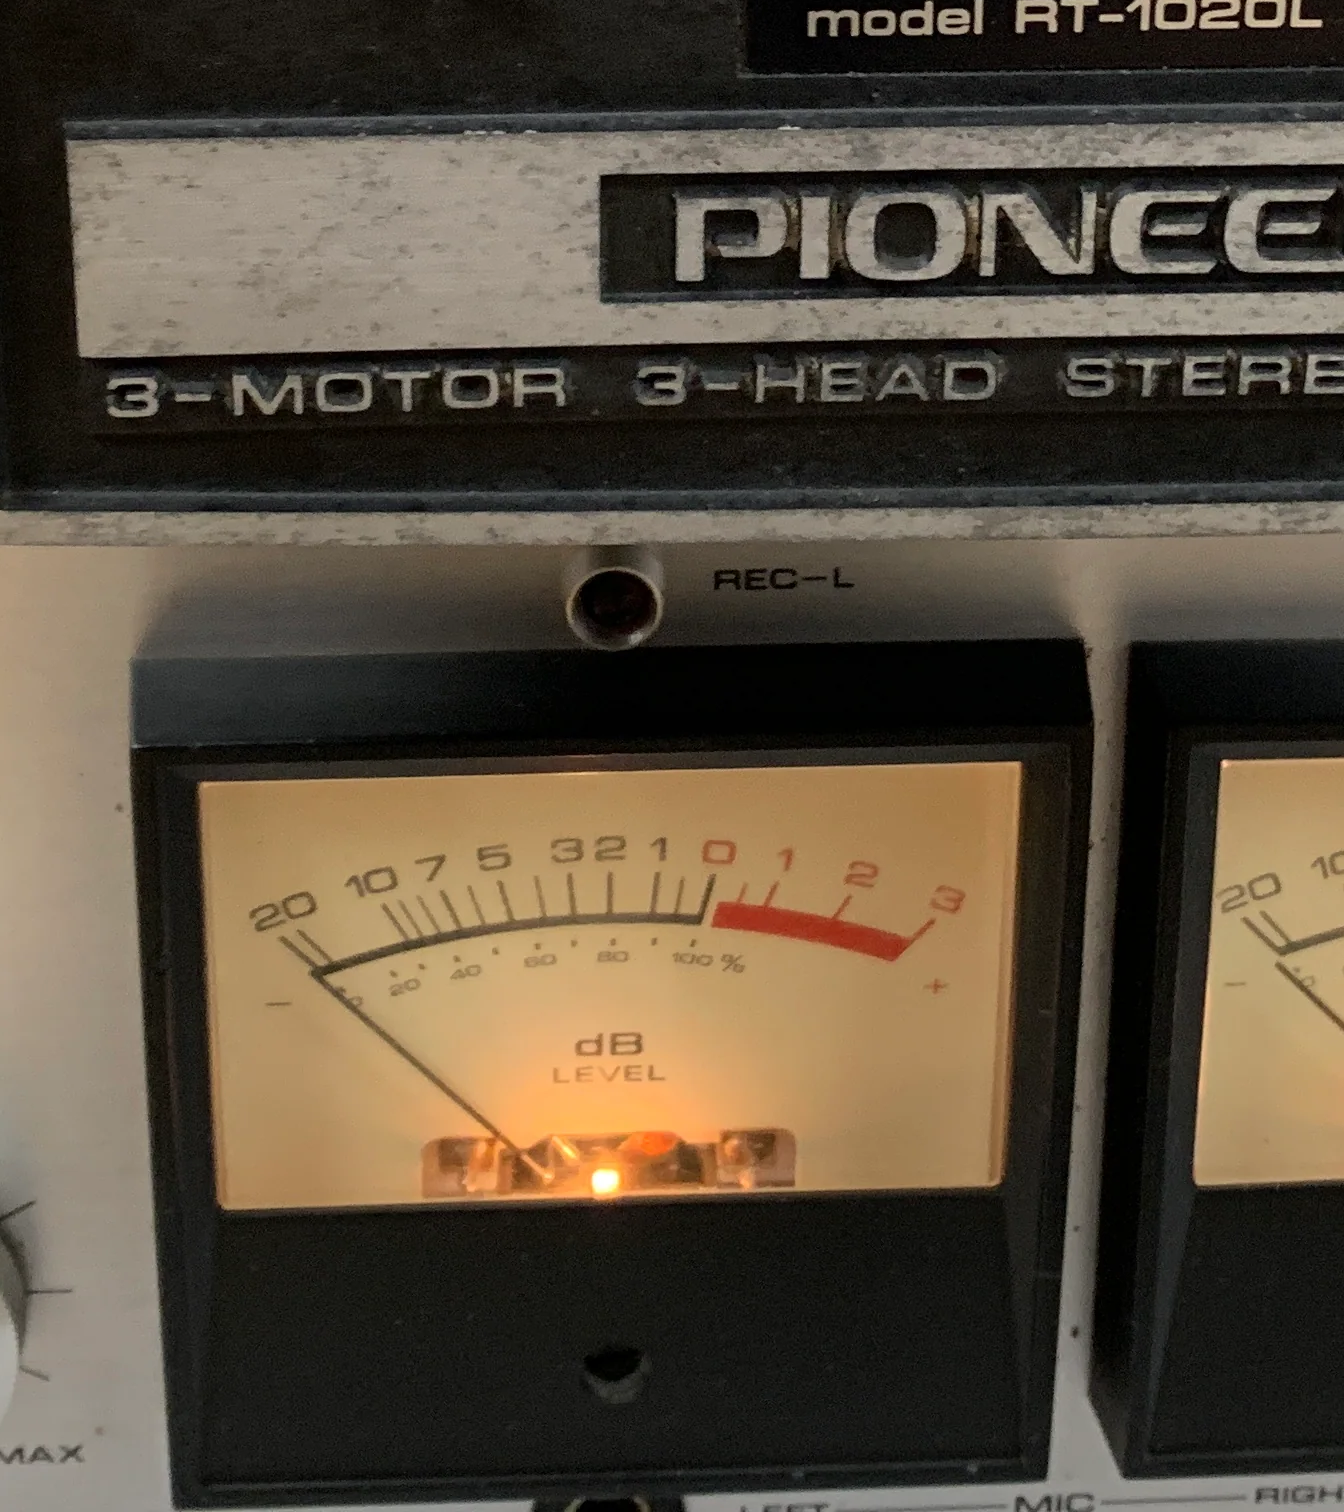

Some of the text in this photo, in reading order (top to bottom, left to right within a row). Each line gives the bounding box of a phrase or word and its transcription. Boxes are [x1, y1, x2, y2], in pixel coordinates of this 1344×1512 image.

[807, 0, 984, 37] model
[104, 366, 568, 420] 3-MOTOR
[633, 359, 998, 406] 3-HEAD
[711, 567, 855, 592] REC-L
[247, 836, 966, 934] 20 10 7 5 3 2 1 0 1 2 3
[1218, 871, 1282, 913] 20
[389, 978, 421, 996] 20
[450, 964, 482, 979] 40
[575, 1032, 643, 1057] dB
[553, 1064, 667, 1084] LEVEL
[1013, 1492, 1095, 1512] MIC
